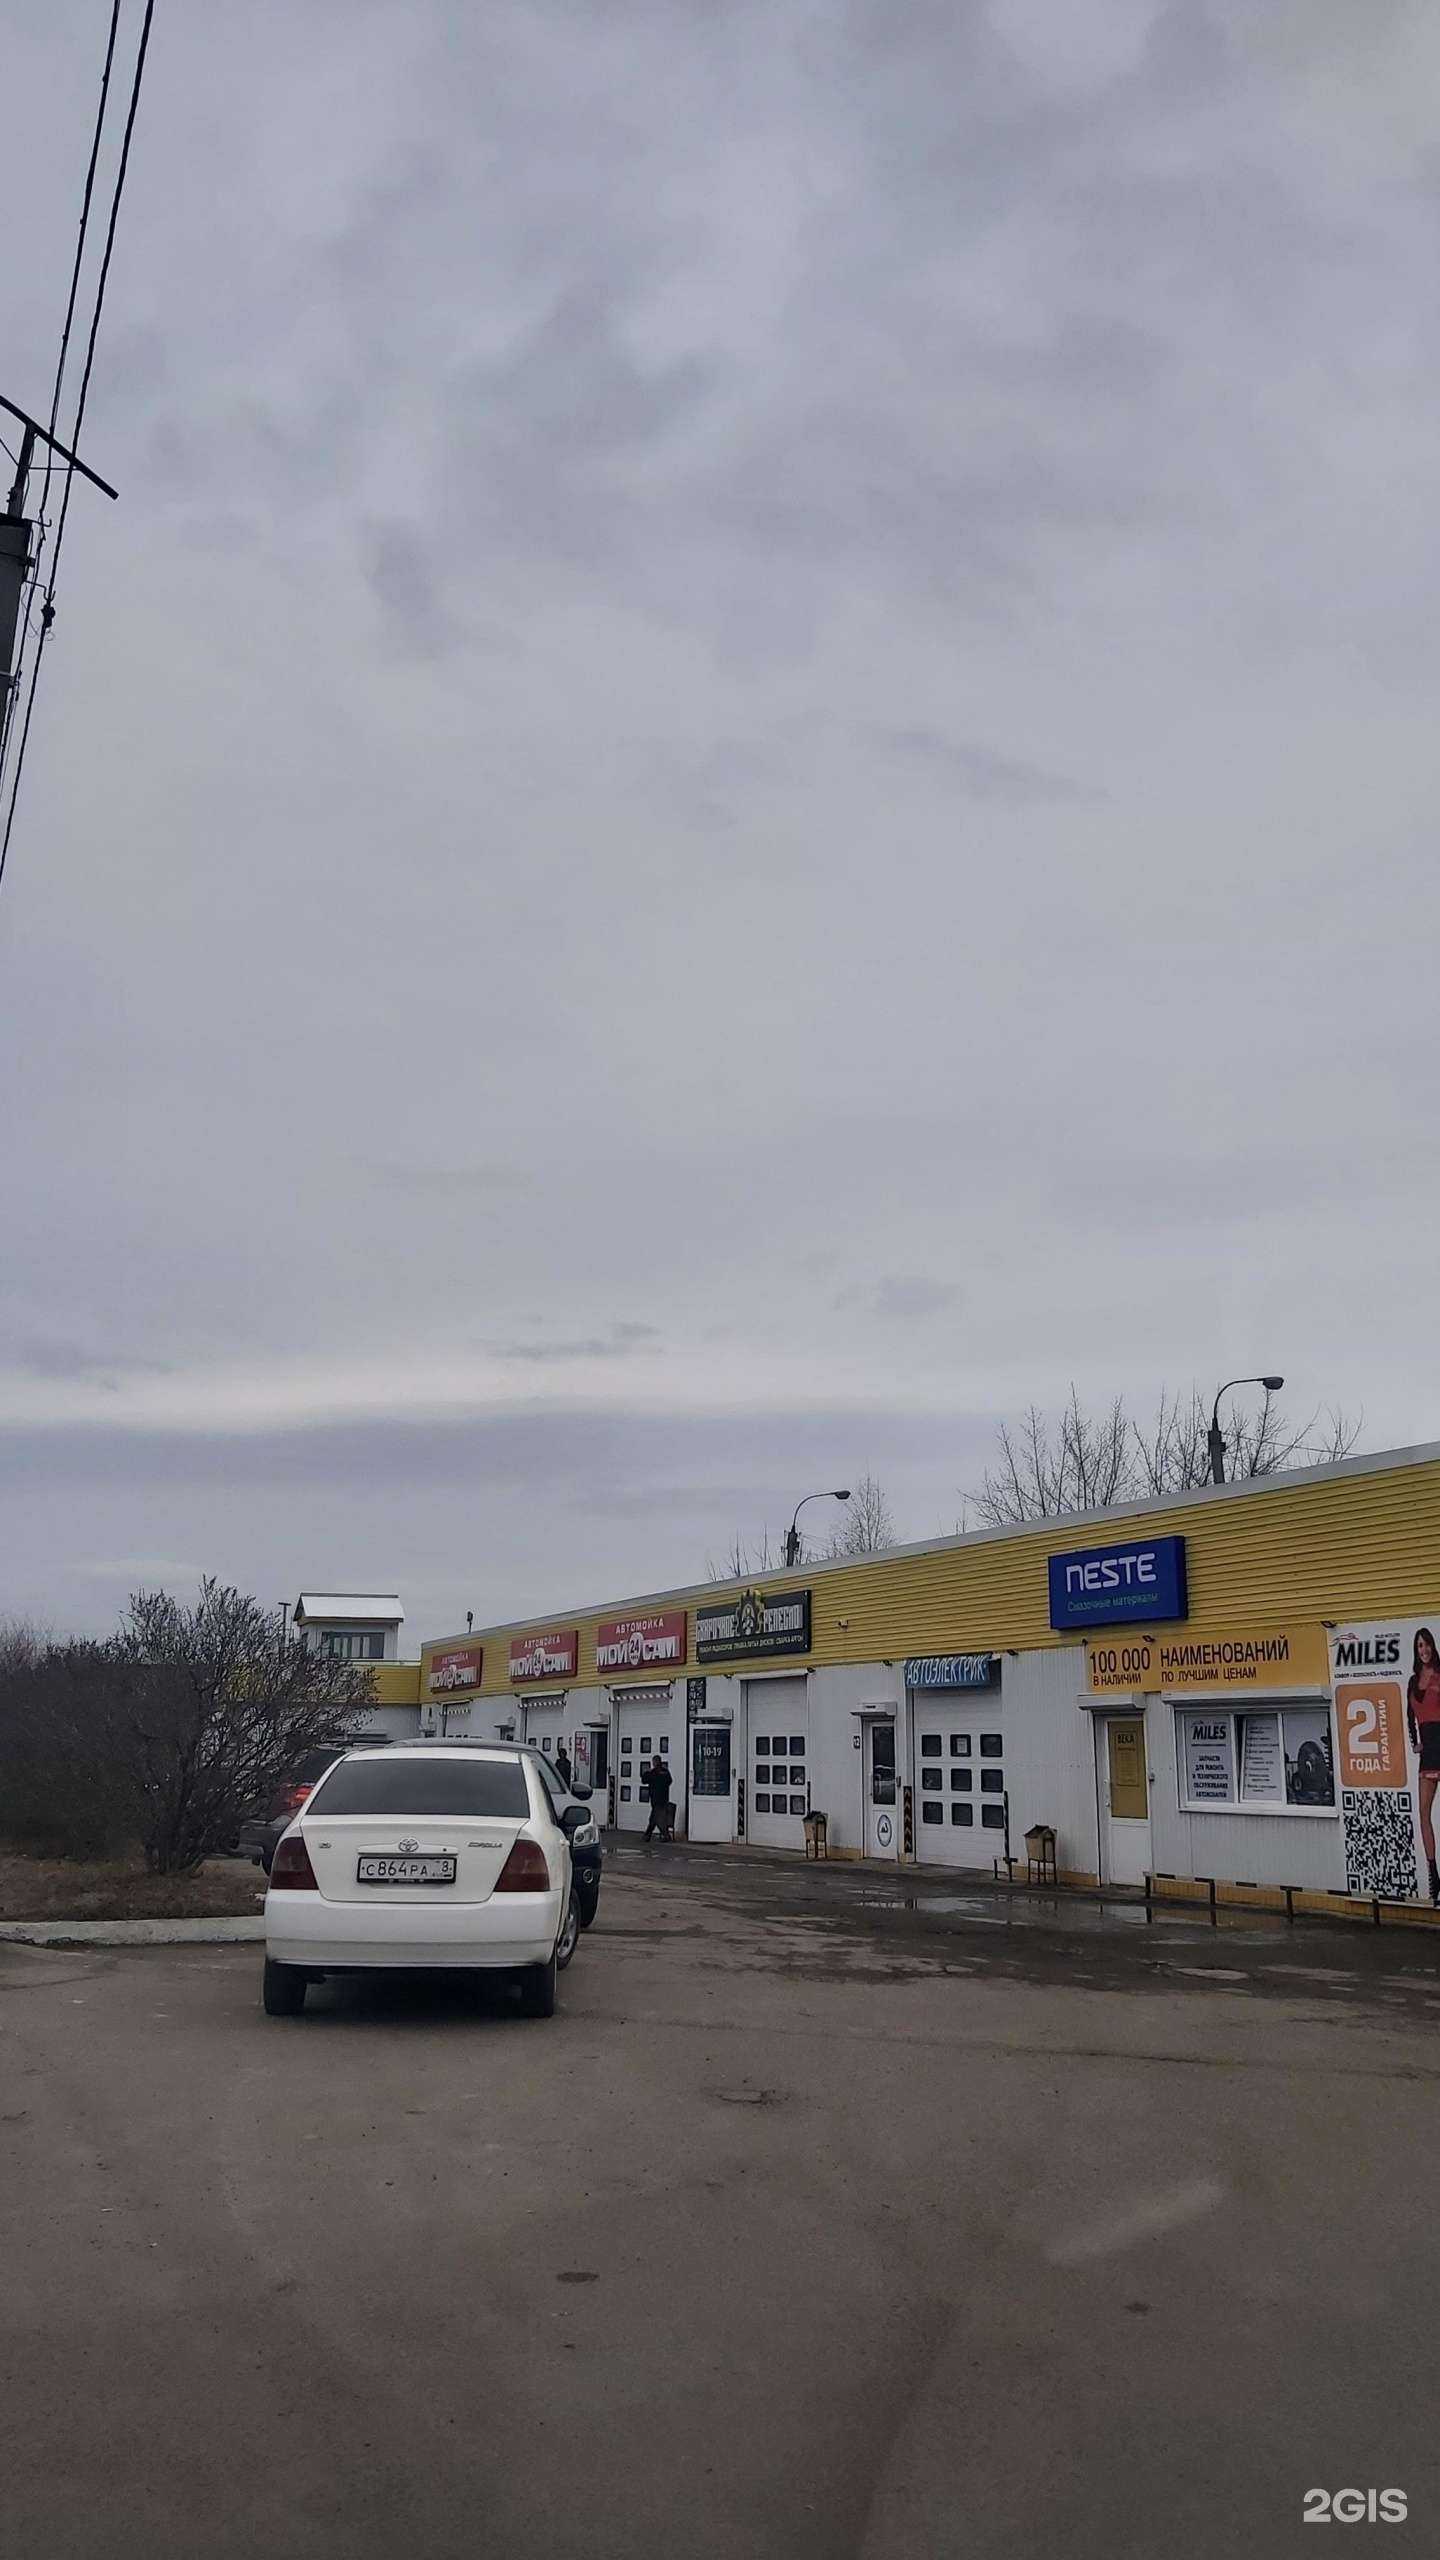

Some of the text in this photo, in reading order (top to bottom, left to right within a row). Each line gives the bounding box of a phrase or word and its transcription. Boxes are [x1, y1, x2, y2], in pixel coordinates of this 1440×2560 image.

[1066, 1552, 1157, 1593] NESTE
[615, 1616, 665, 1634] АВТОМОЙКА
[597, 1640, 629, 1666] МОЙ
[642, 1635, 680, 1661] САМ
[1090, 1635, 1290, 1674] 100 000 НАИМЕНОВАНИЙ
[1335, 1640, 1401, 1668] MILES
[906, 1656, 988, 1684] АВТОЭЛЕКТРИК
[1093, 1667, 1257, 1686] В НАЛИЧИИ ПО ЛУЧШИМ ЦЕНАМ
[1192, 1725, 1227, 1740] MILES
[1347, 1699, 1379, 1754] 2
[1378, 1699, 1392, 1771] ГАРАНТИИ
[1350, 1758, 1381, 1773] ГОДА
